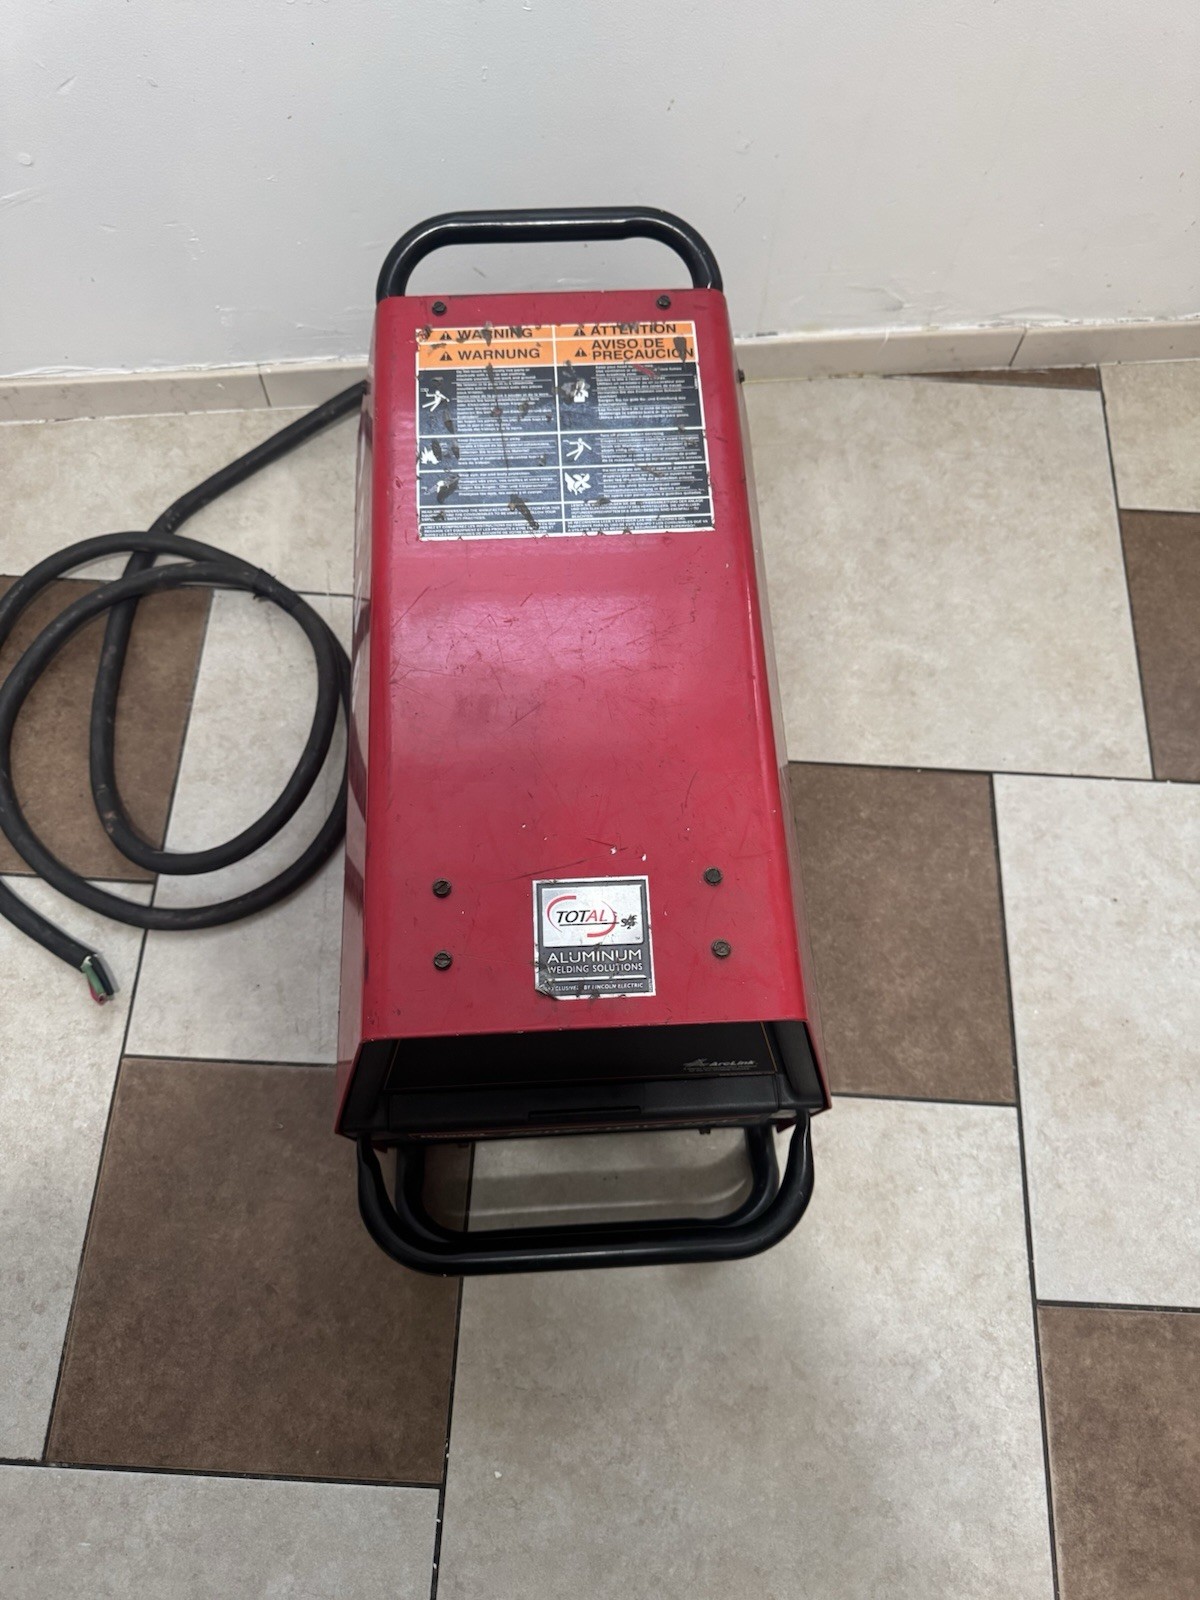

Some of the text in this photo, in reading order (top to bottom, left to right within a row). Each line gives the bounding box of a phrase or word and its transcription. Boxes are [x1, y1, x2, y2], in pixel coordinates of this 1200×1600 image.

[457, 328, 533, 340] WANING
[591, 323, 677, 336] ATTENTION
[591, 337, 665, 350] AVISO DE
[458, 348, 540, 361] WARNUNG
[556, 909, 608, 923] TOTAL
[547, 949, 642, 964] ALUMINUM
[547, 963, 643, 974] WELDING SOLUTIONS
